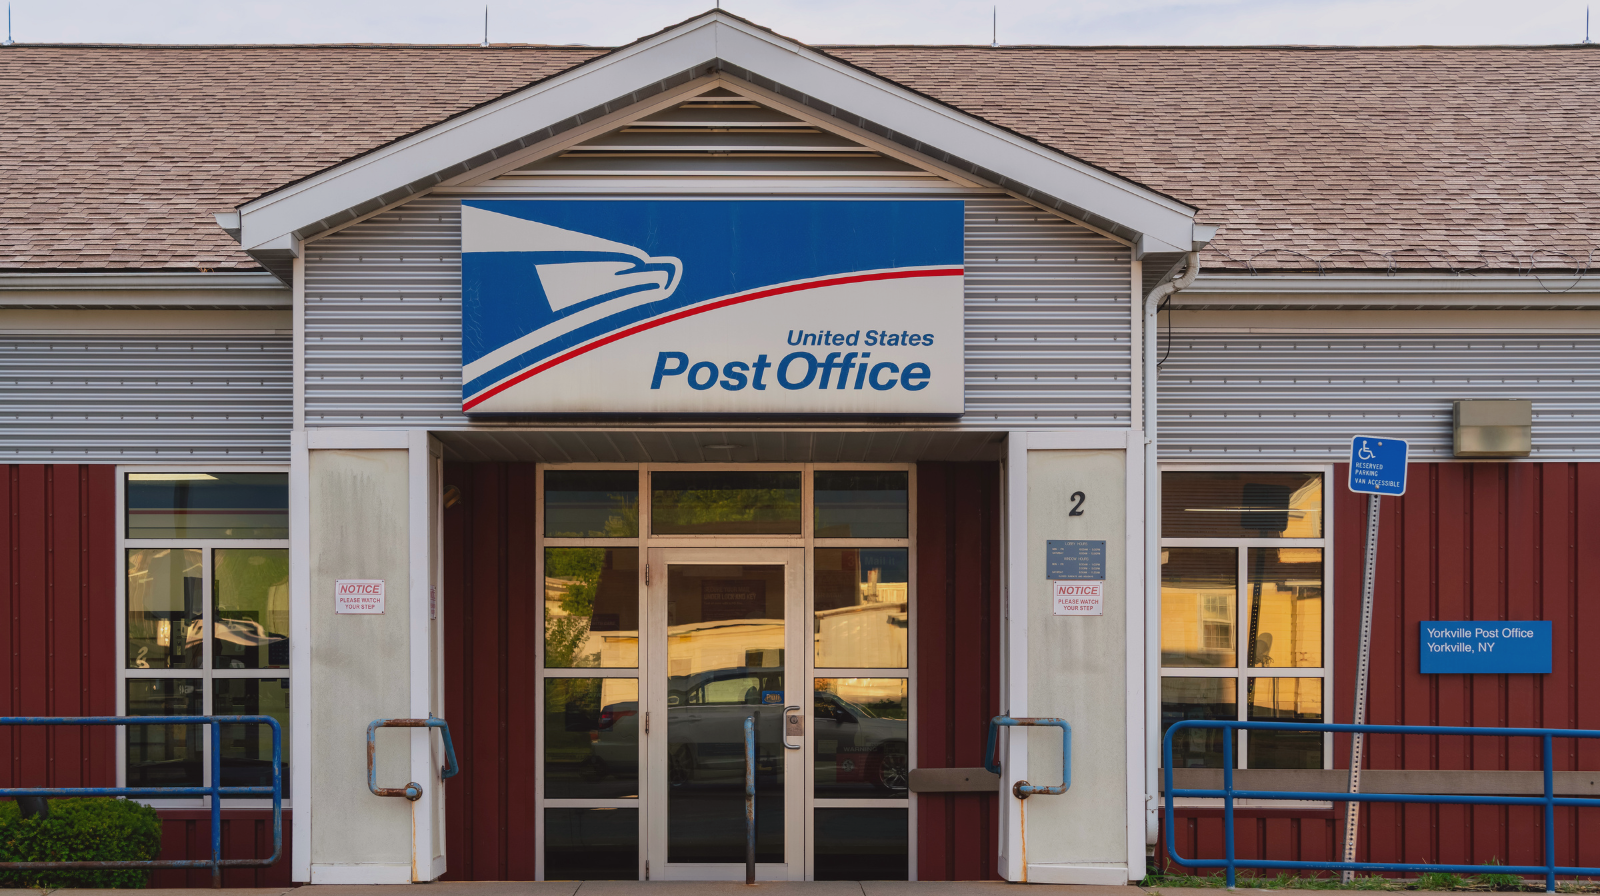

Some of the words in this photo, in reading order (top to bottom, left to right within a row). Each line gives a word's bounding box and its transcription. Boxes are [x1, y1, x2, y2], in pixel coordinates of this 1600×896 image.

[787, 329, 860, 346] United
[864, 329, 934, 346] States
[650, 351, 771, 391] Post
[776, 351, 931, 391] Office
[1355, 462, 1383, 470] RESERVED
[1367, 479, 1400, 487] ACCESSIBLE
[1069, 491, 1085, 516] 2
[864, 556, 886, 566] Mail
[888, 556, 896, 566] it
[340, 584, 380, 594] NOTICE
[1058, 586, 1098, 595] NOTICE
[746, 592, 757, 600] KEY
[1427, 628, 1471, 638] Yorkville
[1475, 628, 1499, 638] Post
[1502, 628, 1533, 638] Office
[1427, 642, 1474, 653] Yorkville,
[1479, 642, 1495, 652] NY
[766, 693, 781, 701] Pull
